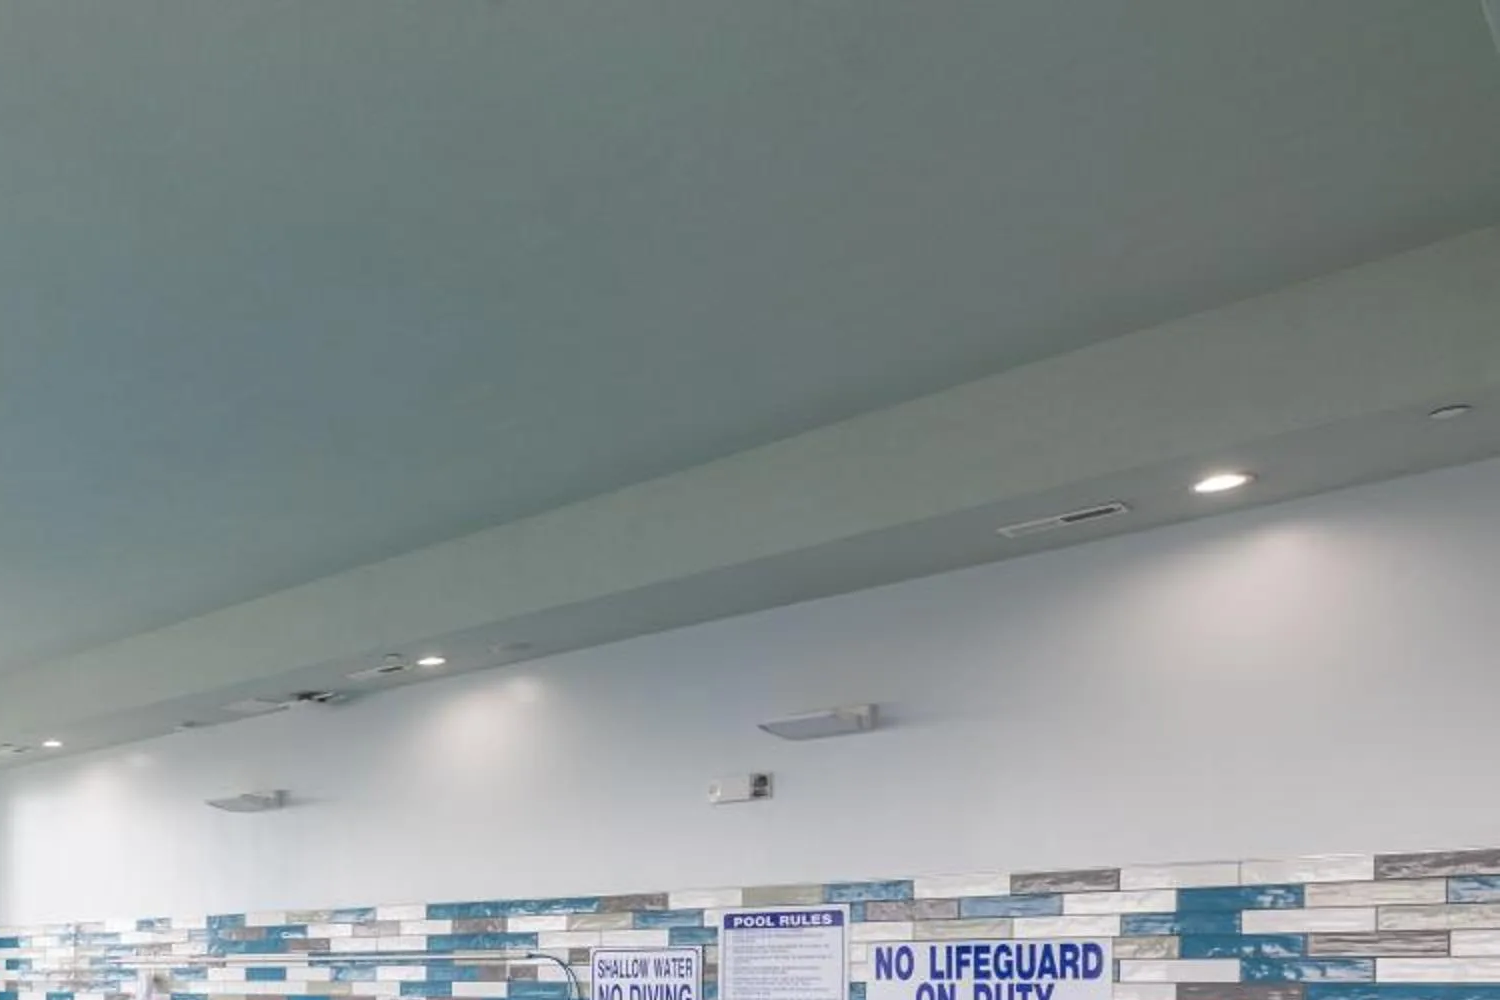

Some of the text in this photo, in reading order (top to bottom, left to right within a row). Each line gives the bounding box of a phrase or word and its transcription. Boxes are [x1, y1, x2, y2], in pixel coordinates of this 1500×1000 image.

[733, 913, 834, 928] POOL RULES
[598, 957, 693, 979] SHALLOW WATER
[875, 943, 1104, 981] NO LIFEGUARD
